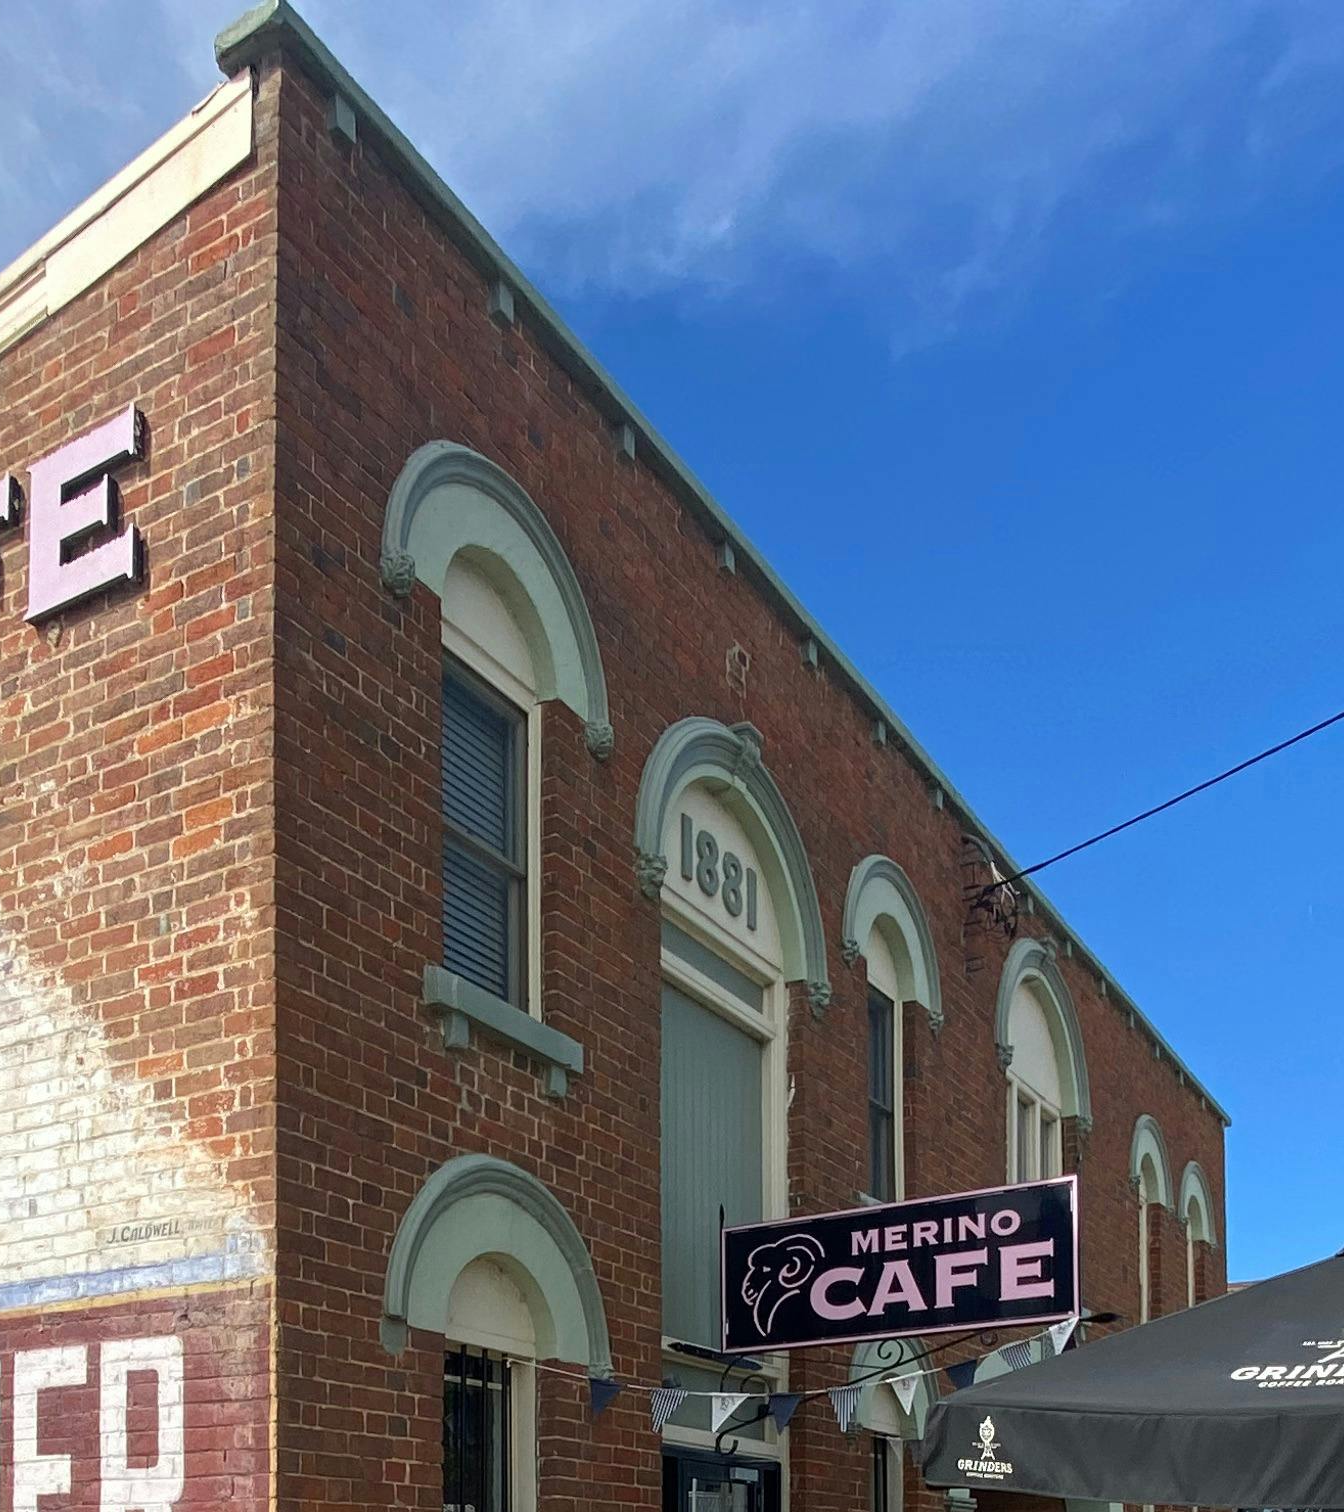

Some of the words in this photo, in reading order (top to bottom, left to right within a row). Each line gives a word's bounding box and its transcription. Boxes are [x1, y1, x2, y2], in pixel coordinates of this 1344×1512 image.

[681, 813, 757, 932] 1881
[851, 1209, 1021, 1256] MERINO
[809, 1238, 1055, 1321] CAFE
[1258, 1379, 1311, 1388] COFFEE
[957, 1459, 1013, 1474] GRINDERS
